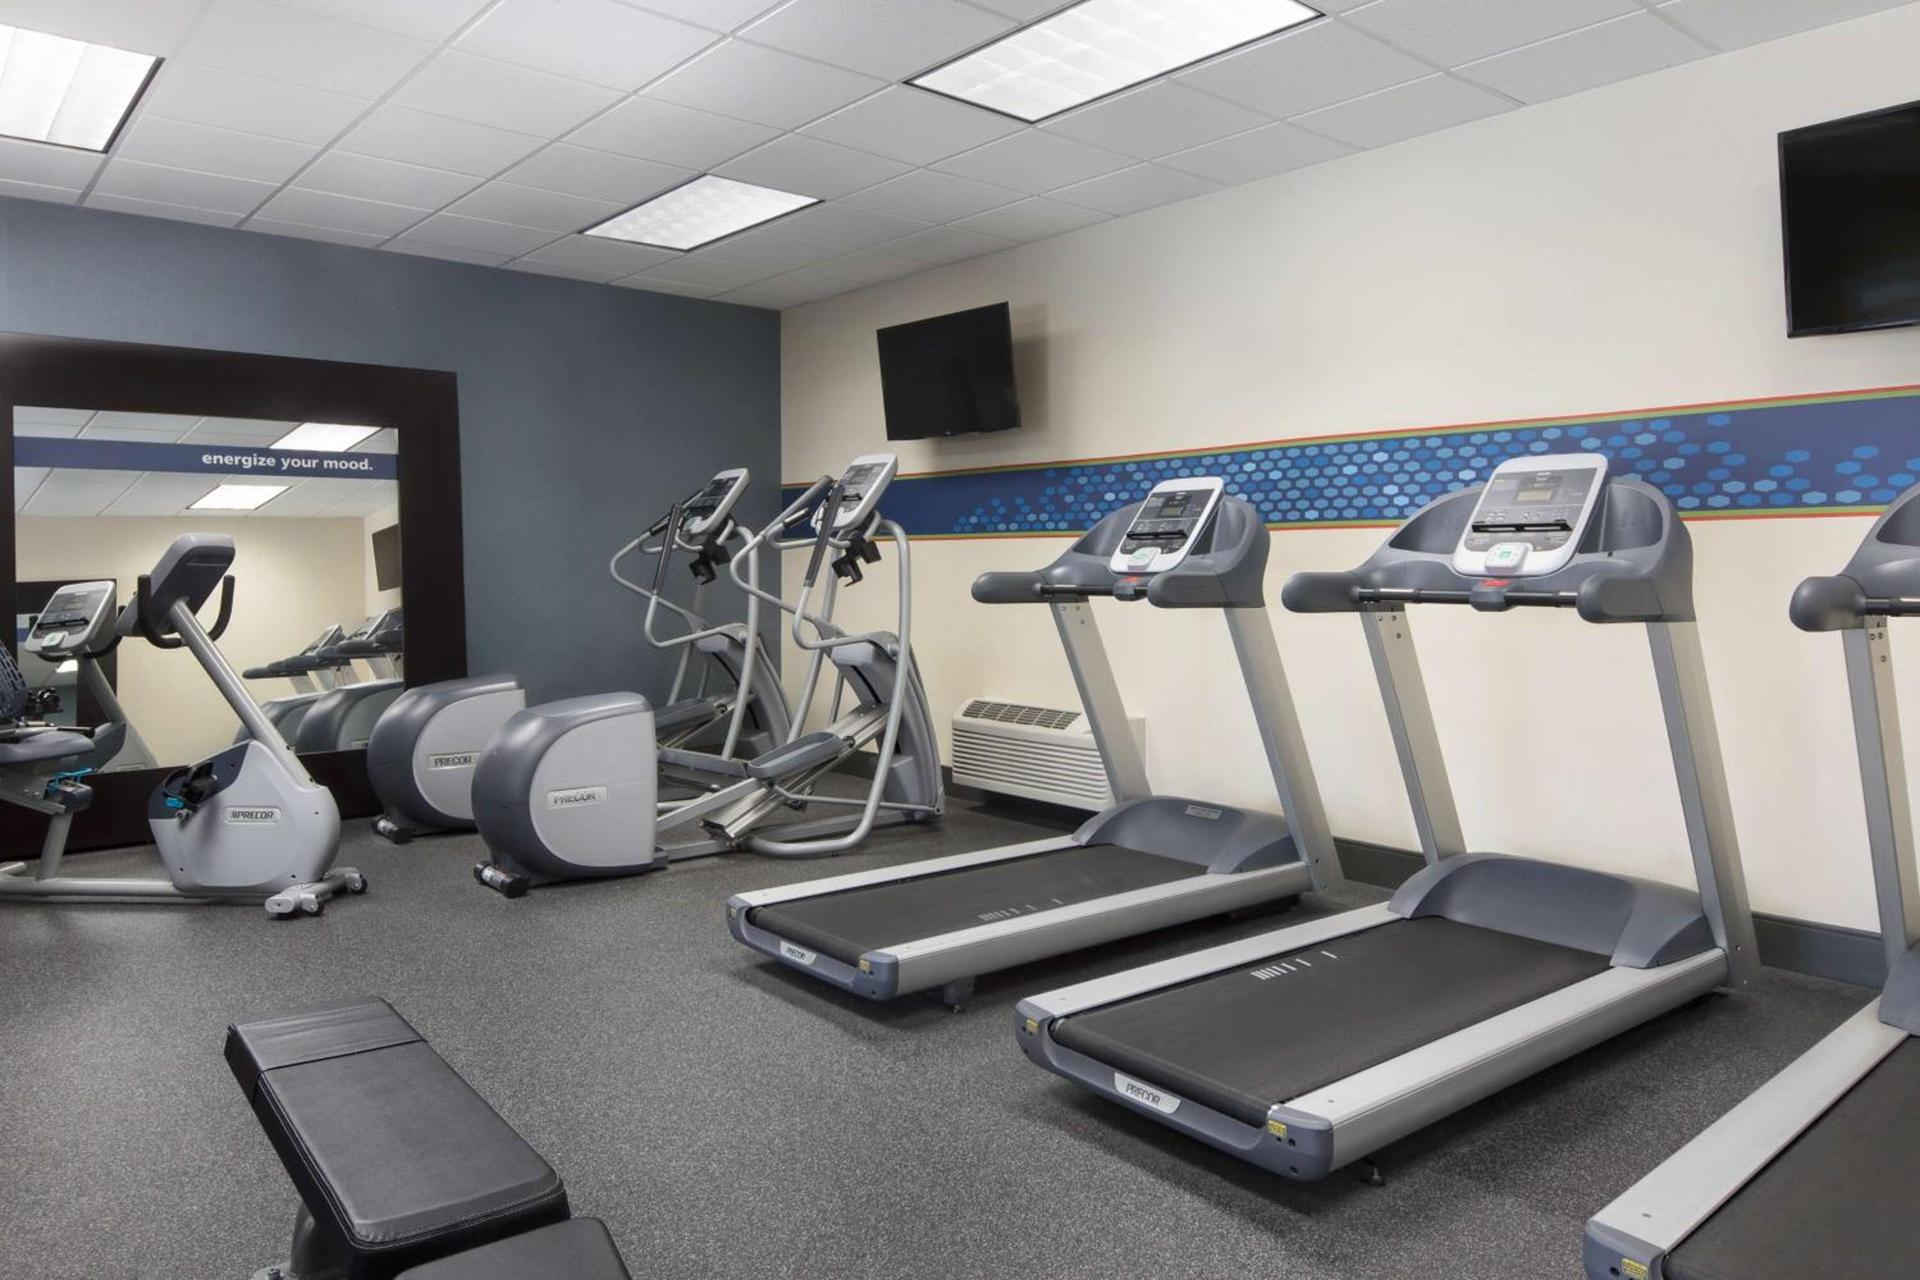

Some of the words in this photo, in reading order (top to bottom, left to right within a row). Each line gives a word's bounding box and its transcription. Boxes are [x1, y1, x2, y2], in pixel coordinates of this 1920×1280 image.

[202, 453, 276, 469] energize
[281, 456, 319, 470] your
[323, 458, 373, 471] mood.
[434, 755, 472, 768] PRECOR
[236, 810, 274, 820] PRECOR
[1126, 1082, 1161, 1105] PRECOR
